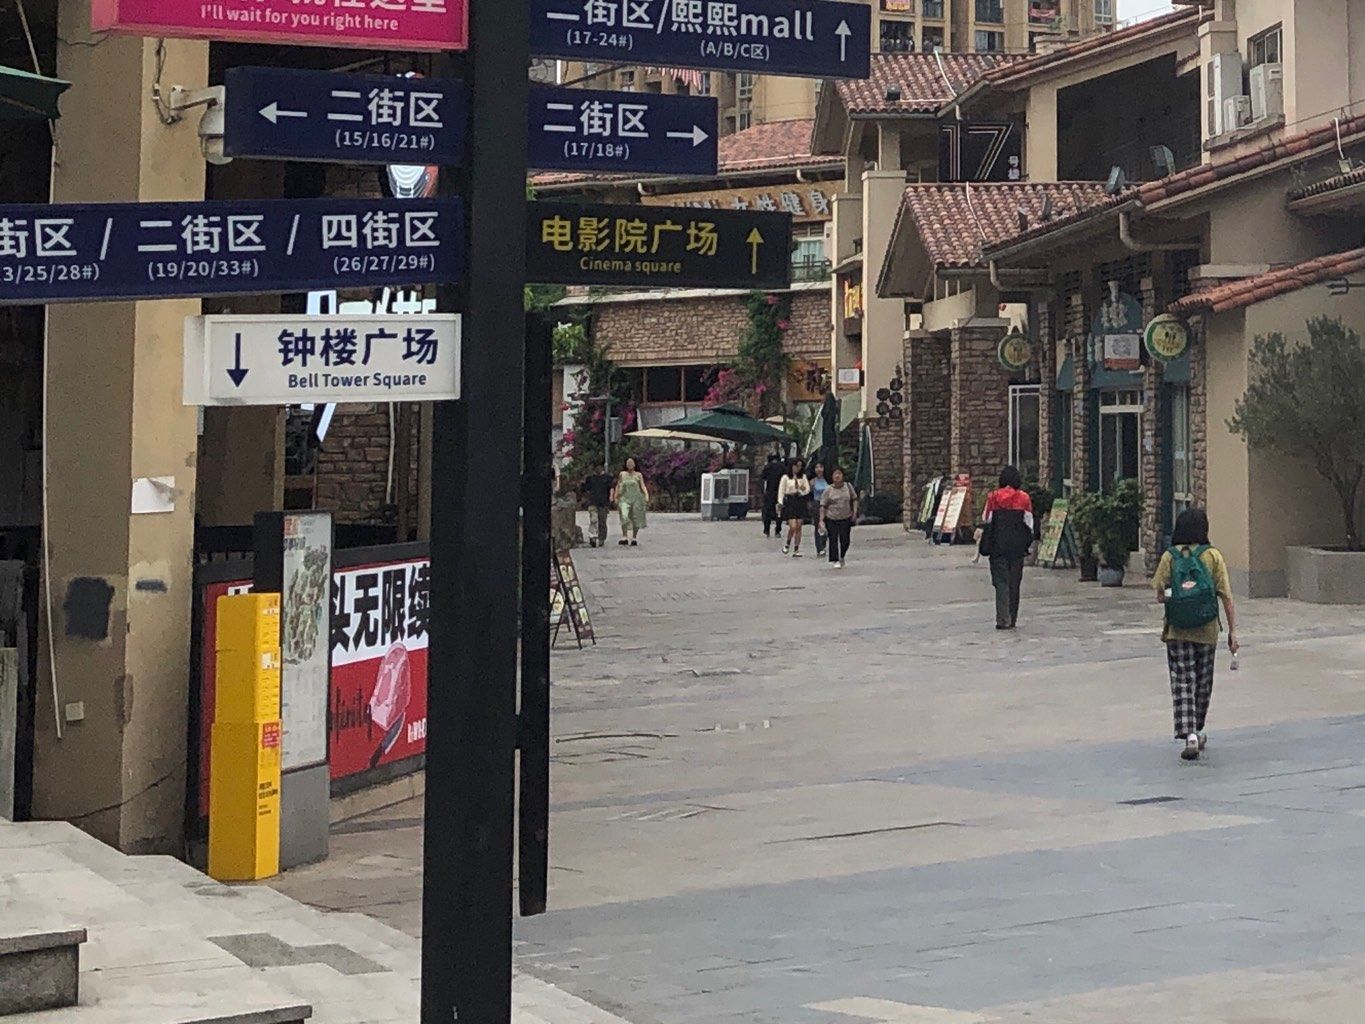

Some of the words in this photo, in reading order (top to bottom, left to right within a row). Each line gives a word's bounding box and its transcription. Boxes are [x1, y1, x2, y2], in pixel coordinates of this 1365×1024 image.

[201, 4, 223, 19] I'll
[226, 7, 261, 23] wait
[265, 8, 288, 24] for
[291, 11, 320, 31] you
[323, 12, 362, 31] right
[364, 13, 399, 30] here
[567, 29, 633, 51] (17-24#)
[700, 39, 770, 61] (A/B/C区)
[327, 88, 443, 128] 二街区
[543, 100, 649, 138] 二街区
[335, 129, 435, 151] (15/16/21#)
[563, 141, 630, 160] (17/18#)
[138, 214, 266, 254] 二街区
[322, 210, 441, 250] 四街区
[541, 214, 718, 256] 电影院广场
[148, 257, 260, 279] (19/20/33#)
[333, 253, 436, 275] (26/27/29#)
[580, 255, 632, 271] Cinema
[636, 259, 681, 274] square
[277, 327, 439, 367] 钟楼广场
[288, 373, 318, 388] Bell
[322, 373, 369, 387] Tower
[373, 372, 427, 389] Square
